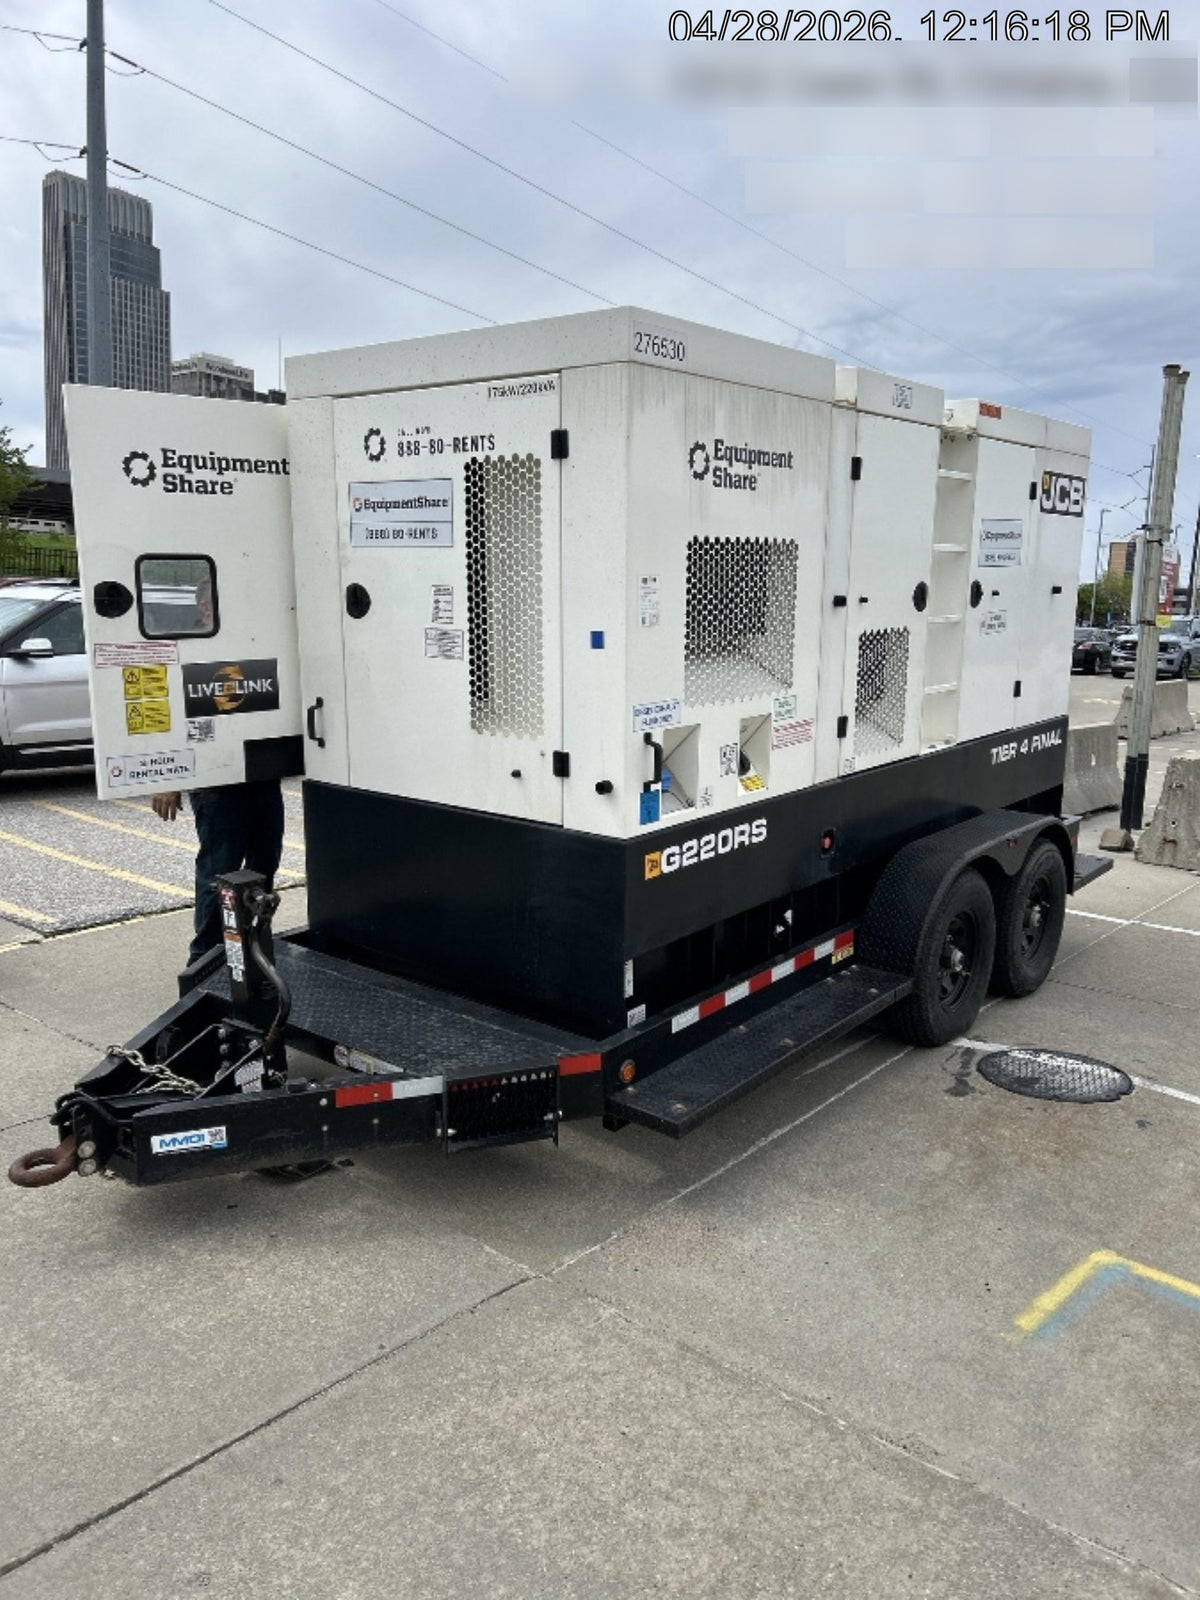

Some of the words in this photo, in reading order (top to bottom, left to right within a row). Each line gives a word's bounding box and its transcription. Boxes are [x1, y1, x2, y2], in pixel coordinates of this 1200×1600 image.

[633, 331, 686, 362] 276530
[160, 447, 290, 475] Equipment
[713, 438, 794, 470] Equipment
[162, 472, 234, 495] Share
[712, 465, 758, 491] Share
[363, 496, 449, 513] EquipmentShare
[1041, 475, 1085, 514] JCB
[990, 741, 1018, 765] TIER
[1020, 738, 1029, 755] 4
[1030, 728, 1063, 753] FINAL
[661, 817, 768, 874] G220RS
